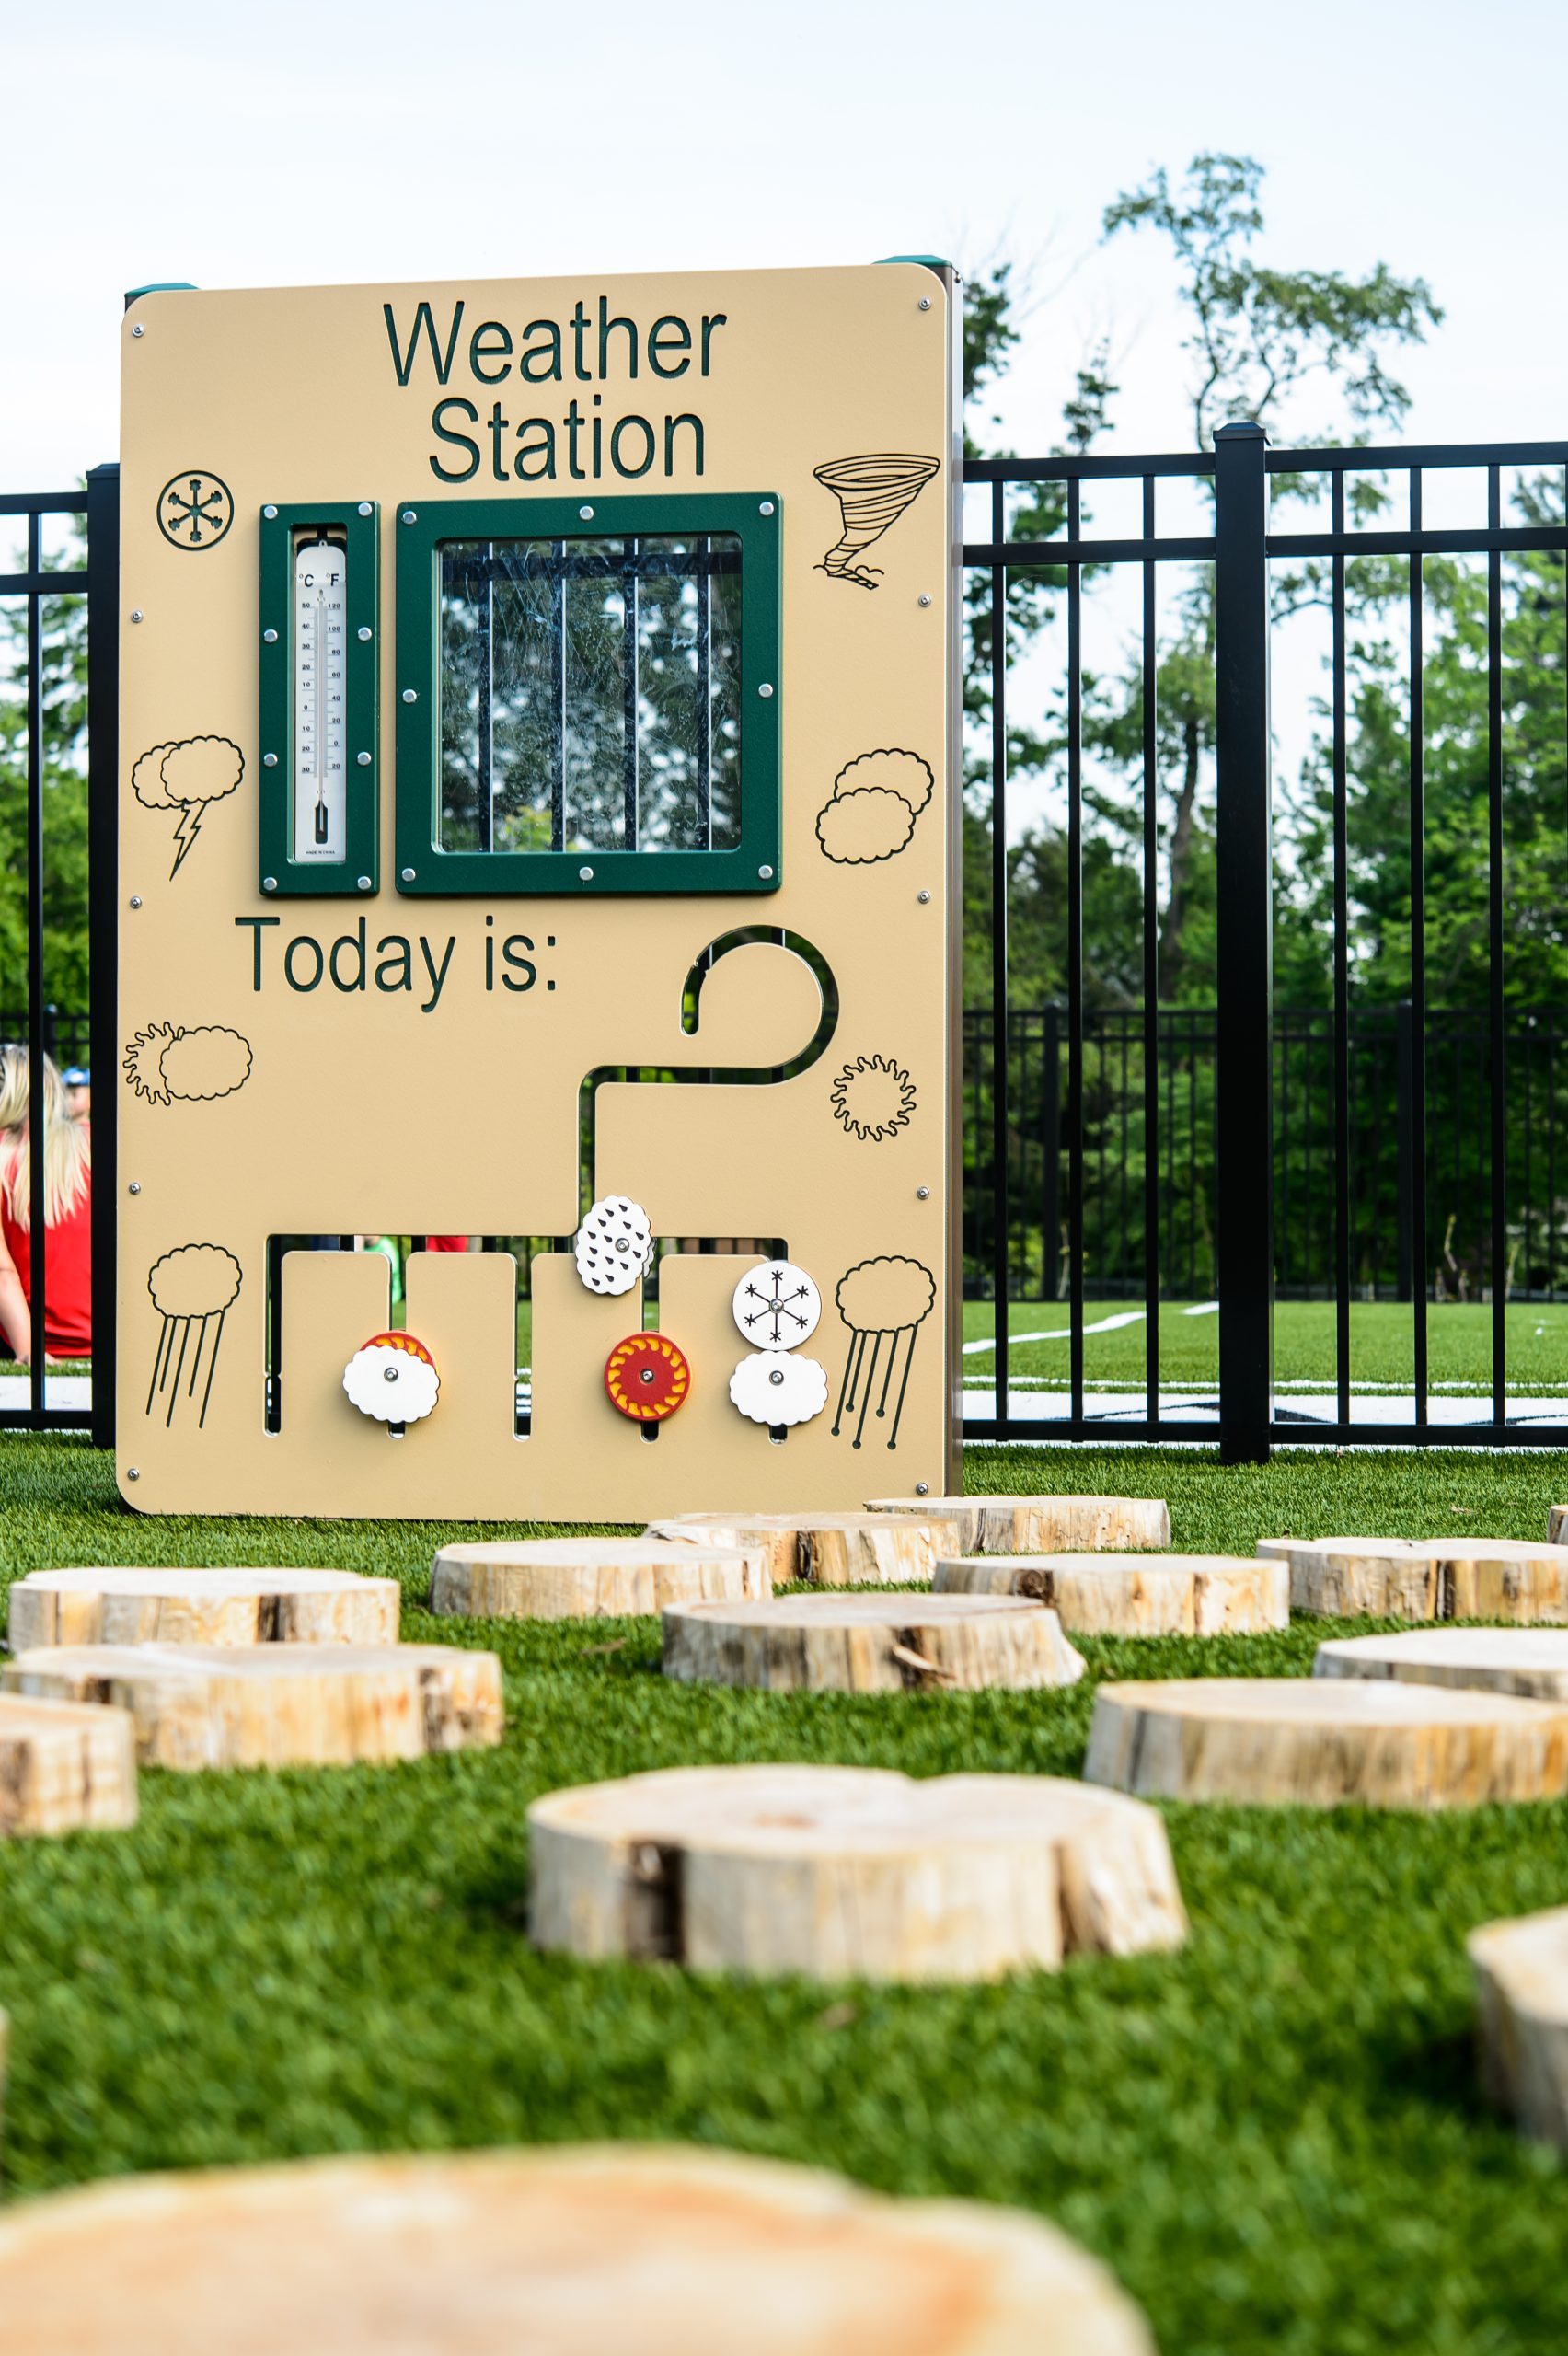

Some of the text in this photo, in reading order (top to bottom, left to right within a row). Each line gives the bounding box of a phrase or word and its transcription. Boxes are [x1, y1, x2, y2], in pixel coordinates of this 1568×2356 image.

[383, 295, 727, 386] Weather
[429, 394, 704, 483] Station
[235, 915, 556, 1013] Today is:
